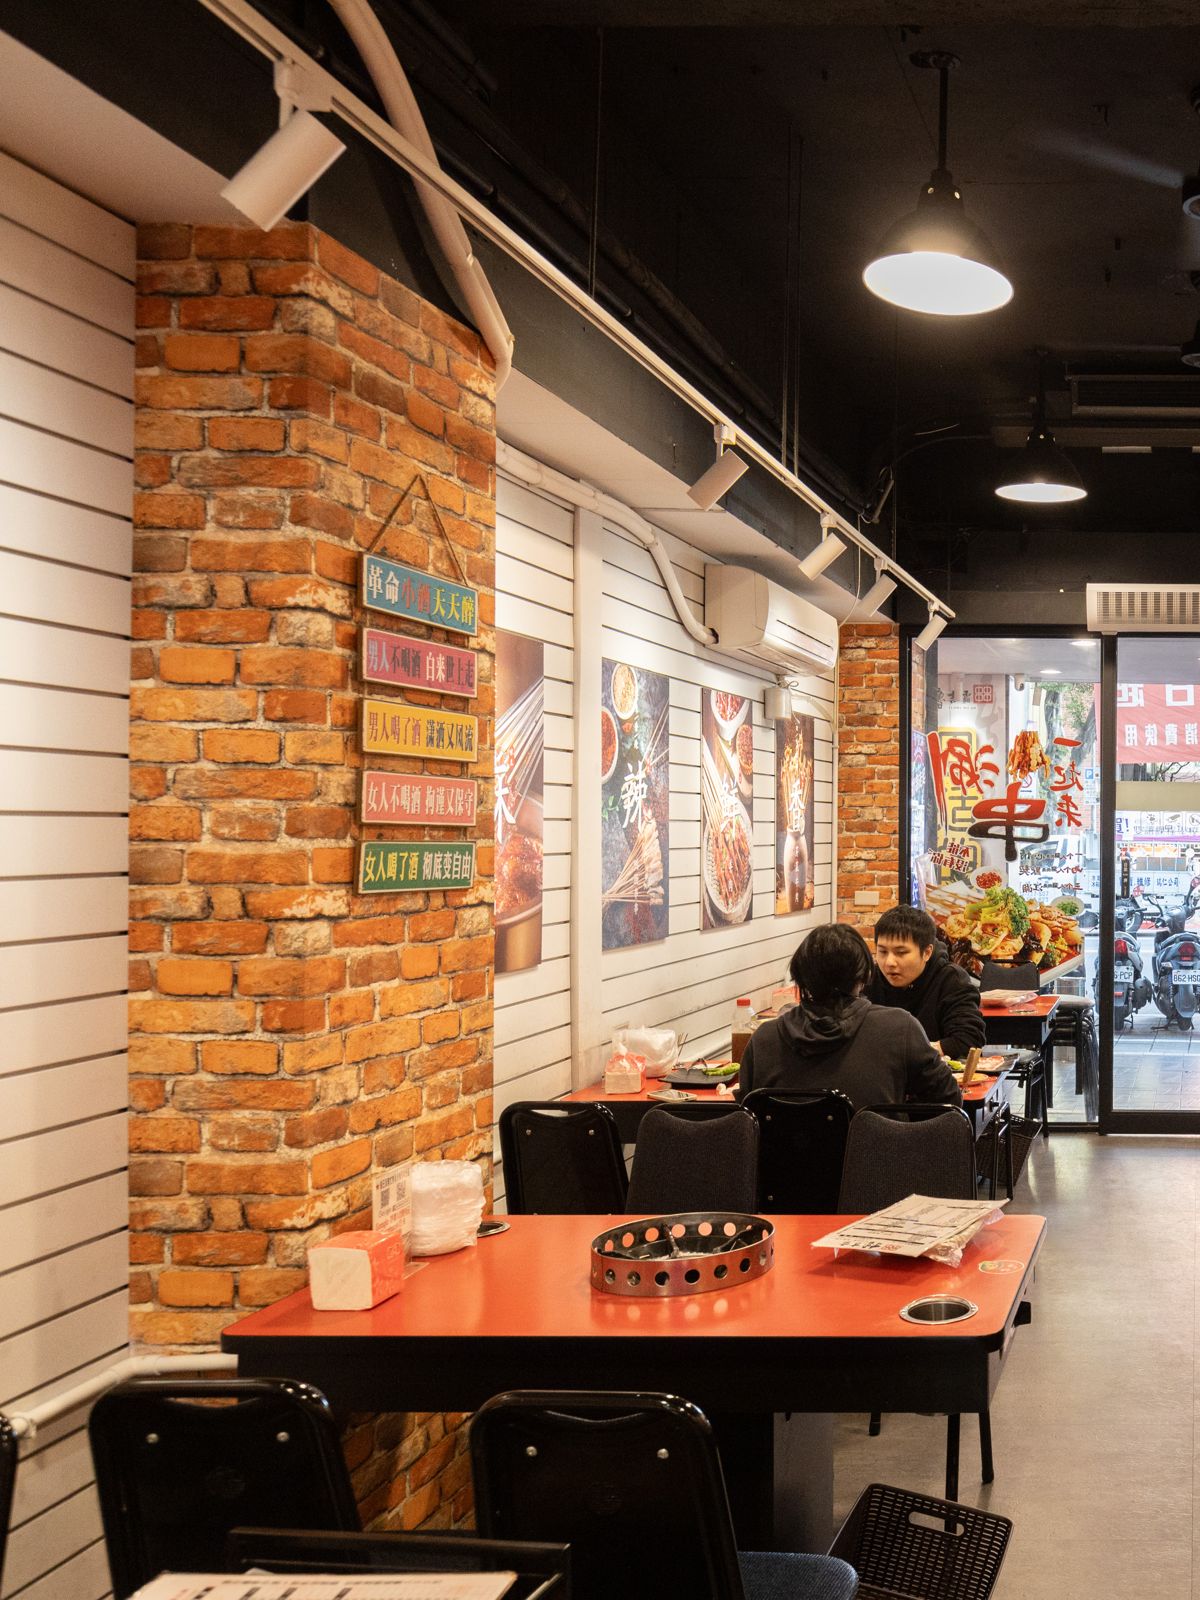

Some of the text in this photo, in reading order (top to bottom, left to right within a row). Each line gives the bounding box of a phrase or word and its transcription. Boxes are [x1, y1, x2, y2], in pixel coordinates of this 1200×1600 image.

[367, 564, 475, 624] 革命小酒天天醉
[367, 643, 474, 689] 男人不喝酒 白来世上走
[367, 712, 474, 753] 男人喝了酒 潇洒又风流
[366, 785, 473, 819] 女人不喝酒 拘谨又保守
[622, 761, 648, 834] 辣
[364, 851, 472, 884] 女人喝了酒 彻底变自由
